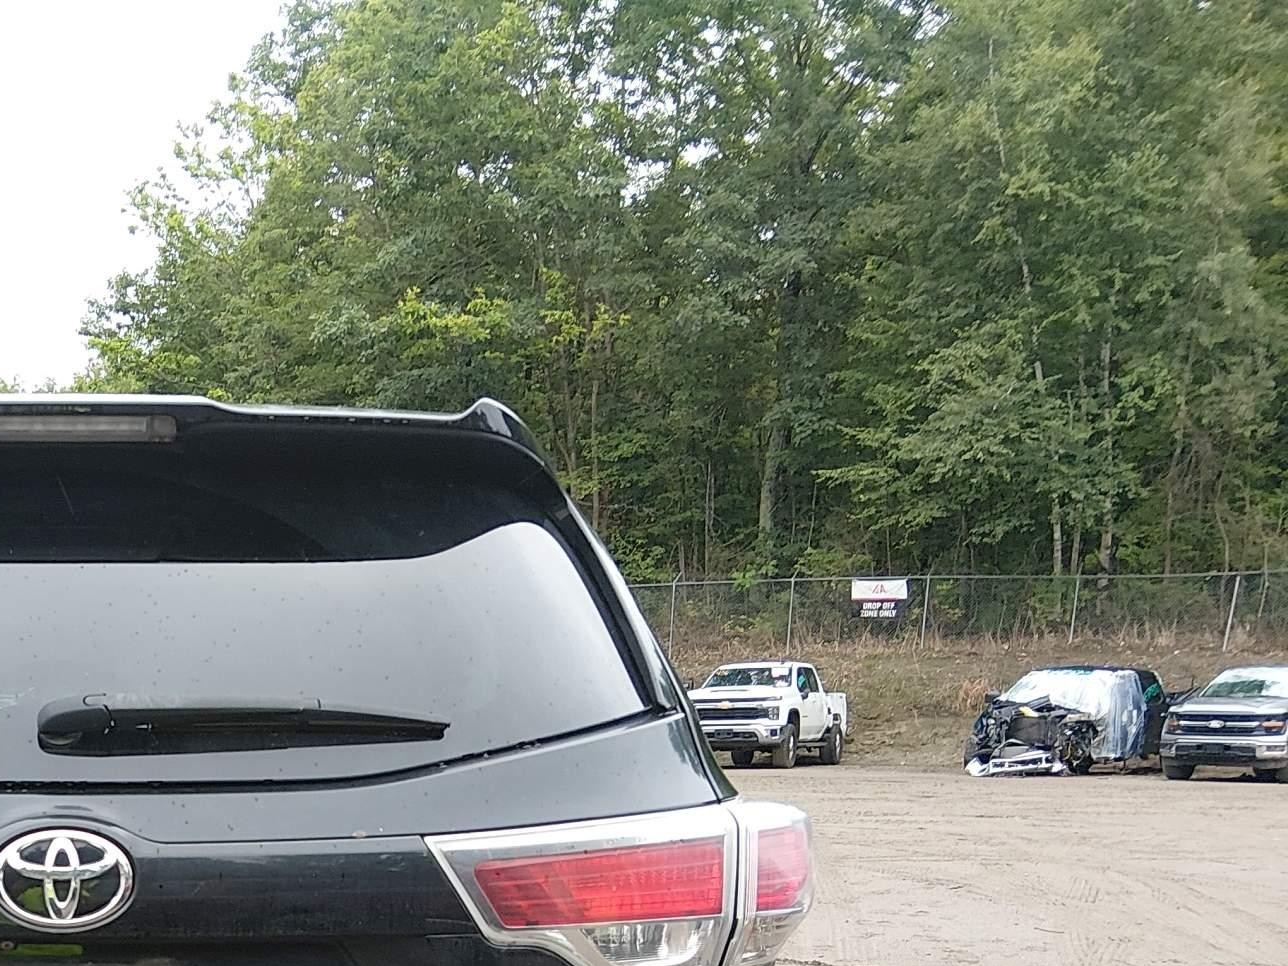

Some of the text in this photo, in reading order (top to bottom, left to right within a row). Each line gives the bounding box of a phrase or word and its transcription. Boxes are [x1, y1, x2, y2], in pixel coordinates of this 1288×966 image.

[862, 602, 896, 610] DROP OFF
[860, 610, 897, 618] ZONE ONLY
